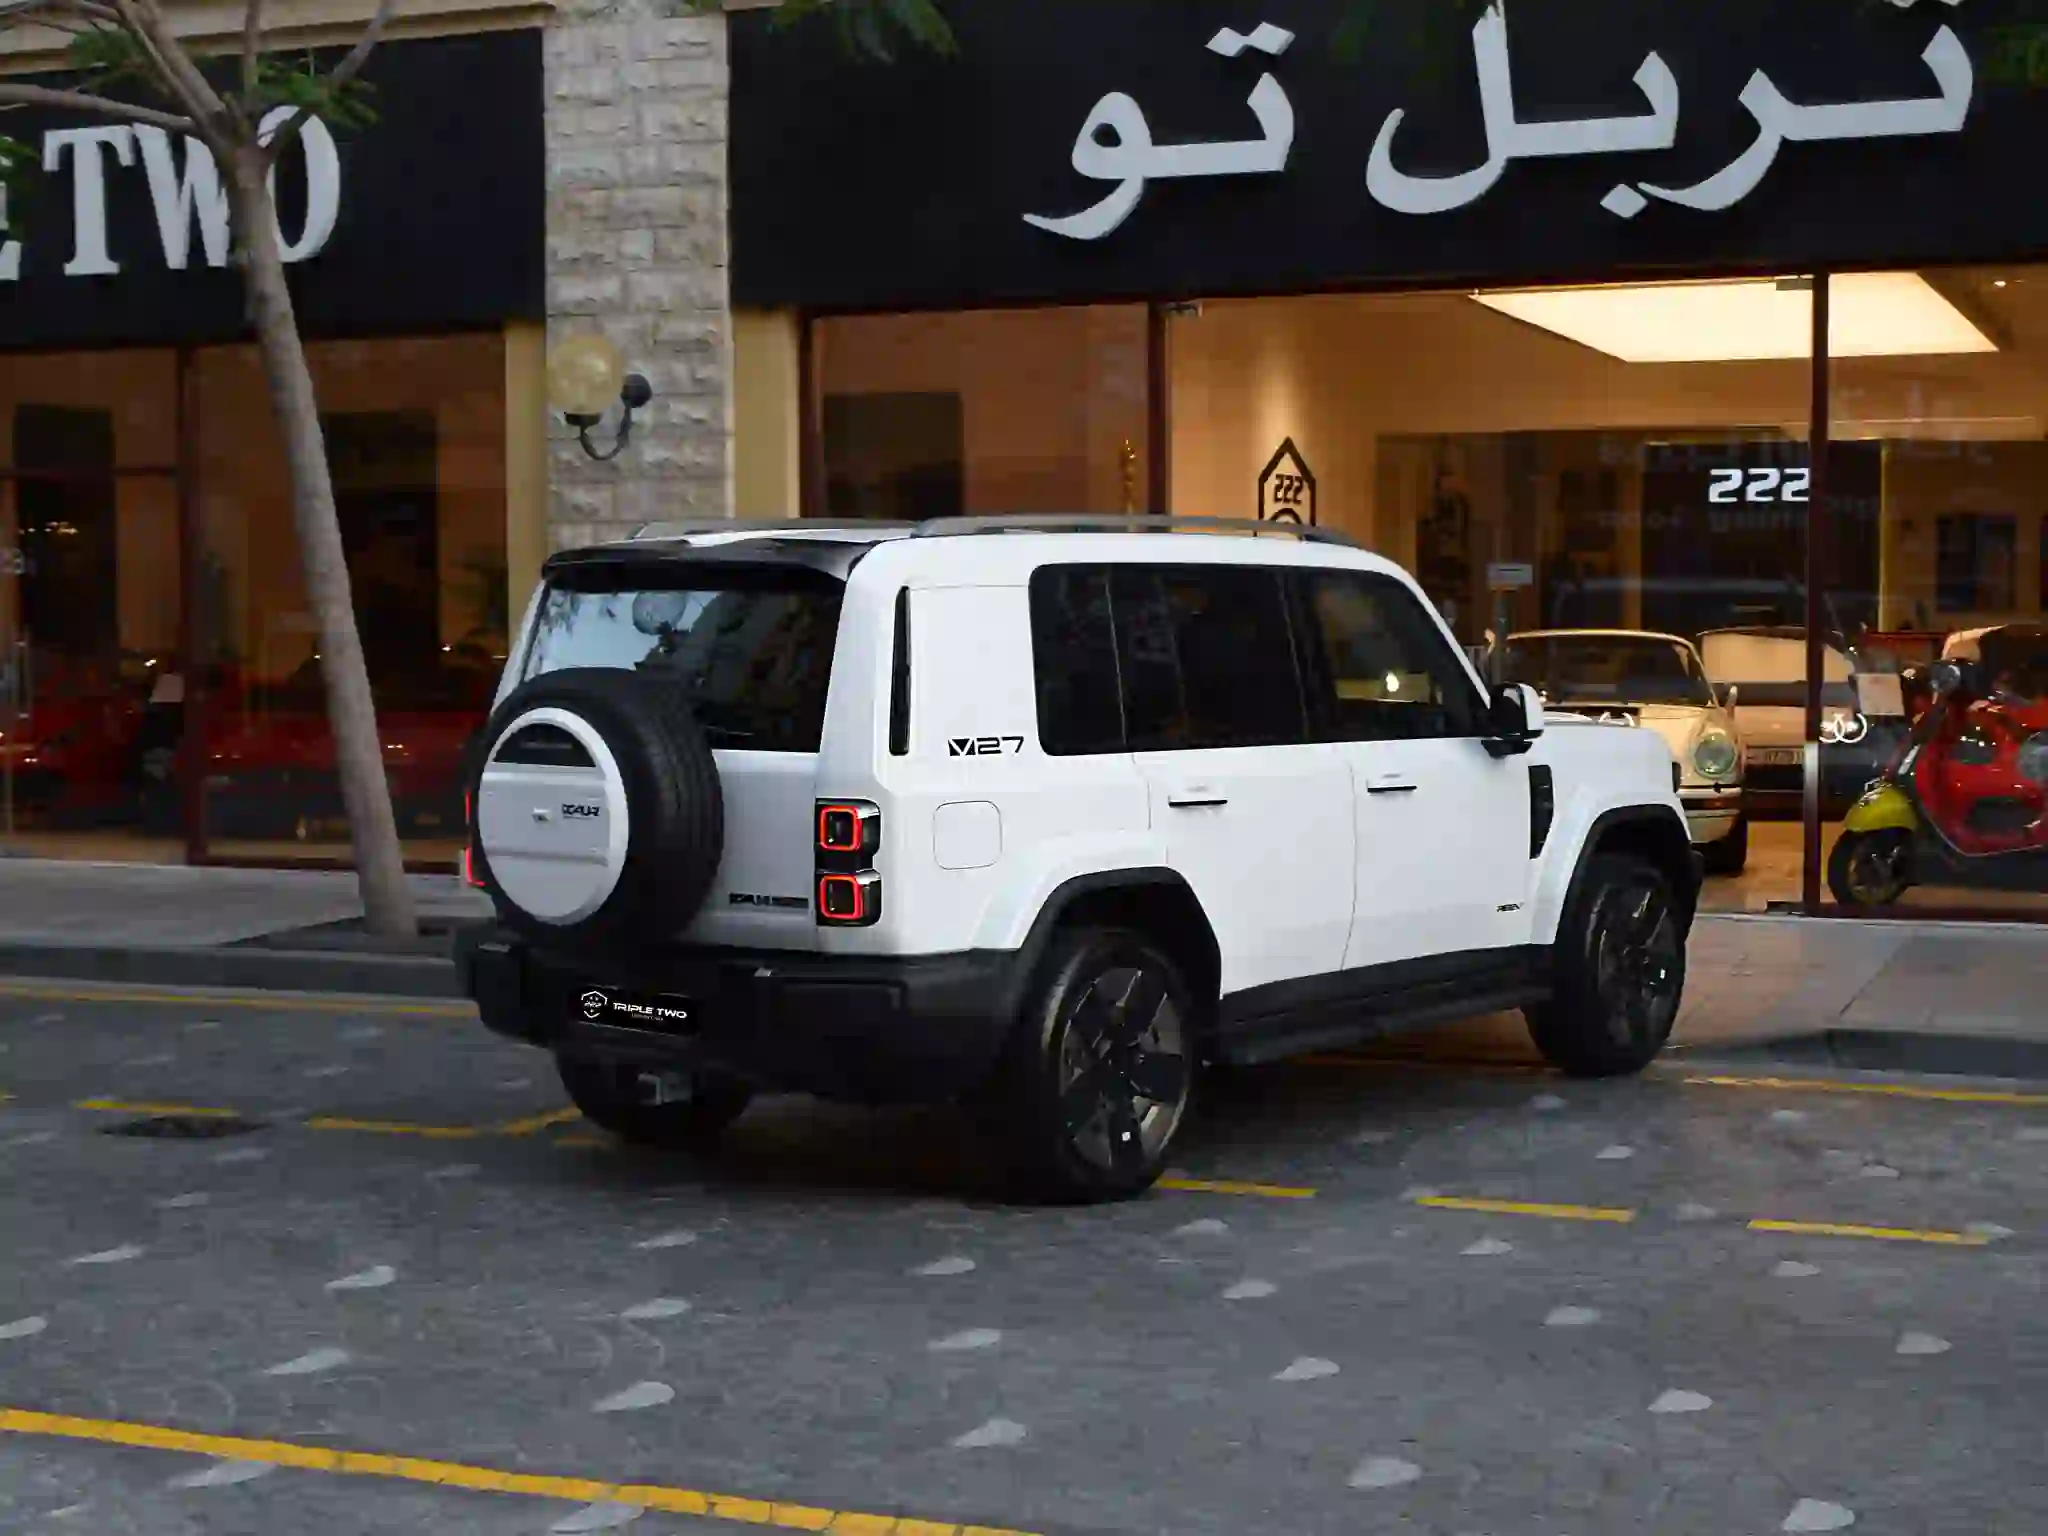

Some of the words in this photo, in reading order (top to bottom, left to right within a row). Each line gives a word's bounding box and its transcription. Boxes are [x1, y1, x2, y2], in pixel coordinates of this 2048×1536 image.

[1022, 21, 1296, 240] تو
[43, 105, 340, 277] TWO
[1274, 474, 1303, 504] 222
[1707, 468, 1811, 503] 222
[613, 1002, 654, 1014] TRIPLE
[656, 1008, 687, 1019] TWO
